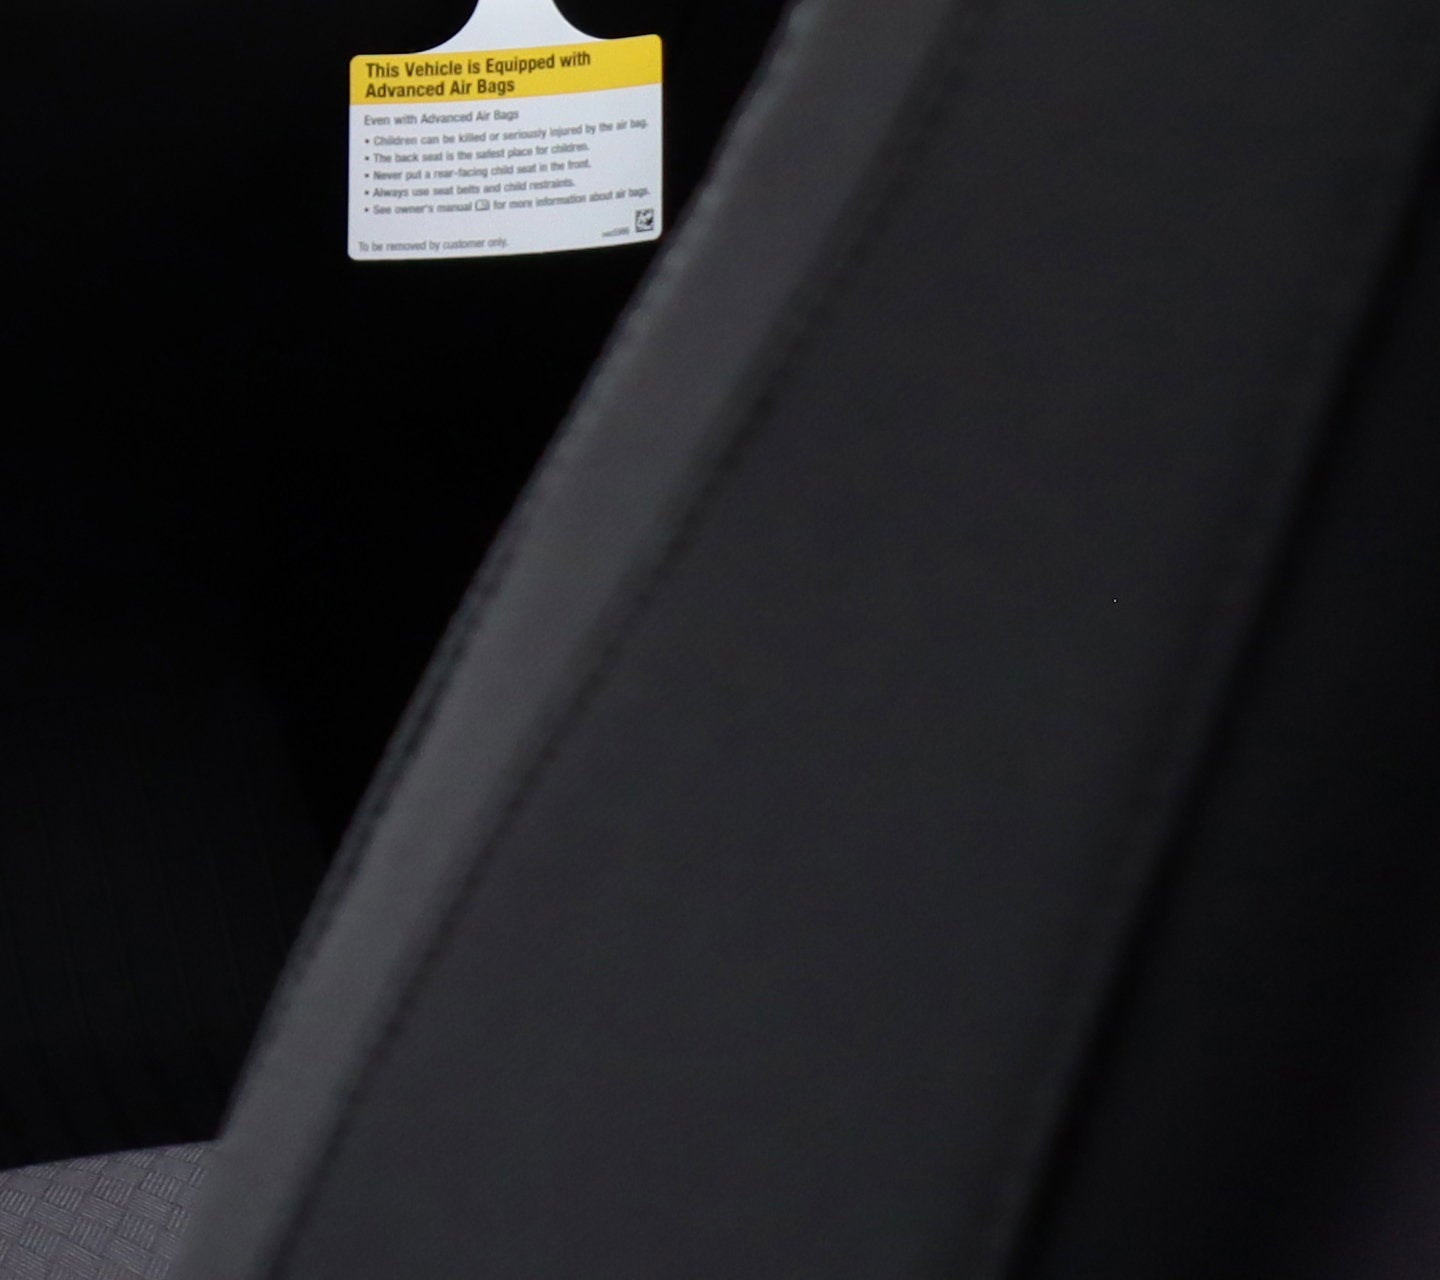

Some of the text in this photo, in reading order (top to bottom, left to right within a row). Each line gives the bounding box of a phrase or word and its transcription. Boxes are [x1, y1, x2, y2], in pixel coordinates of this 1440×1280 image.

[365, 51, 590, 78] This Vehicle is Equipped with
[364, 78, 514, 97] Advanced Air Bags
[363, 109, 519, 126] Even with Advanced Air Bags
[373, 118, 648, 146] Children can be killed or seriously injured by the air bag.
[373, 142, 589, 163] The back seat is the safest place for children.
[373, 158, 591, 181] Never put a rear-facing child seat in the front.
[373, 178, 574, 198] Always use seat belts and child restraints.
[373, 187, 650, 215] See owner's manual for more information about air bags.
[357, 237, 507, 252] To be removed by customer only.
